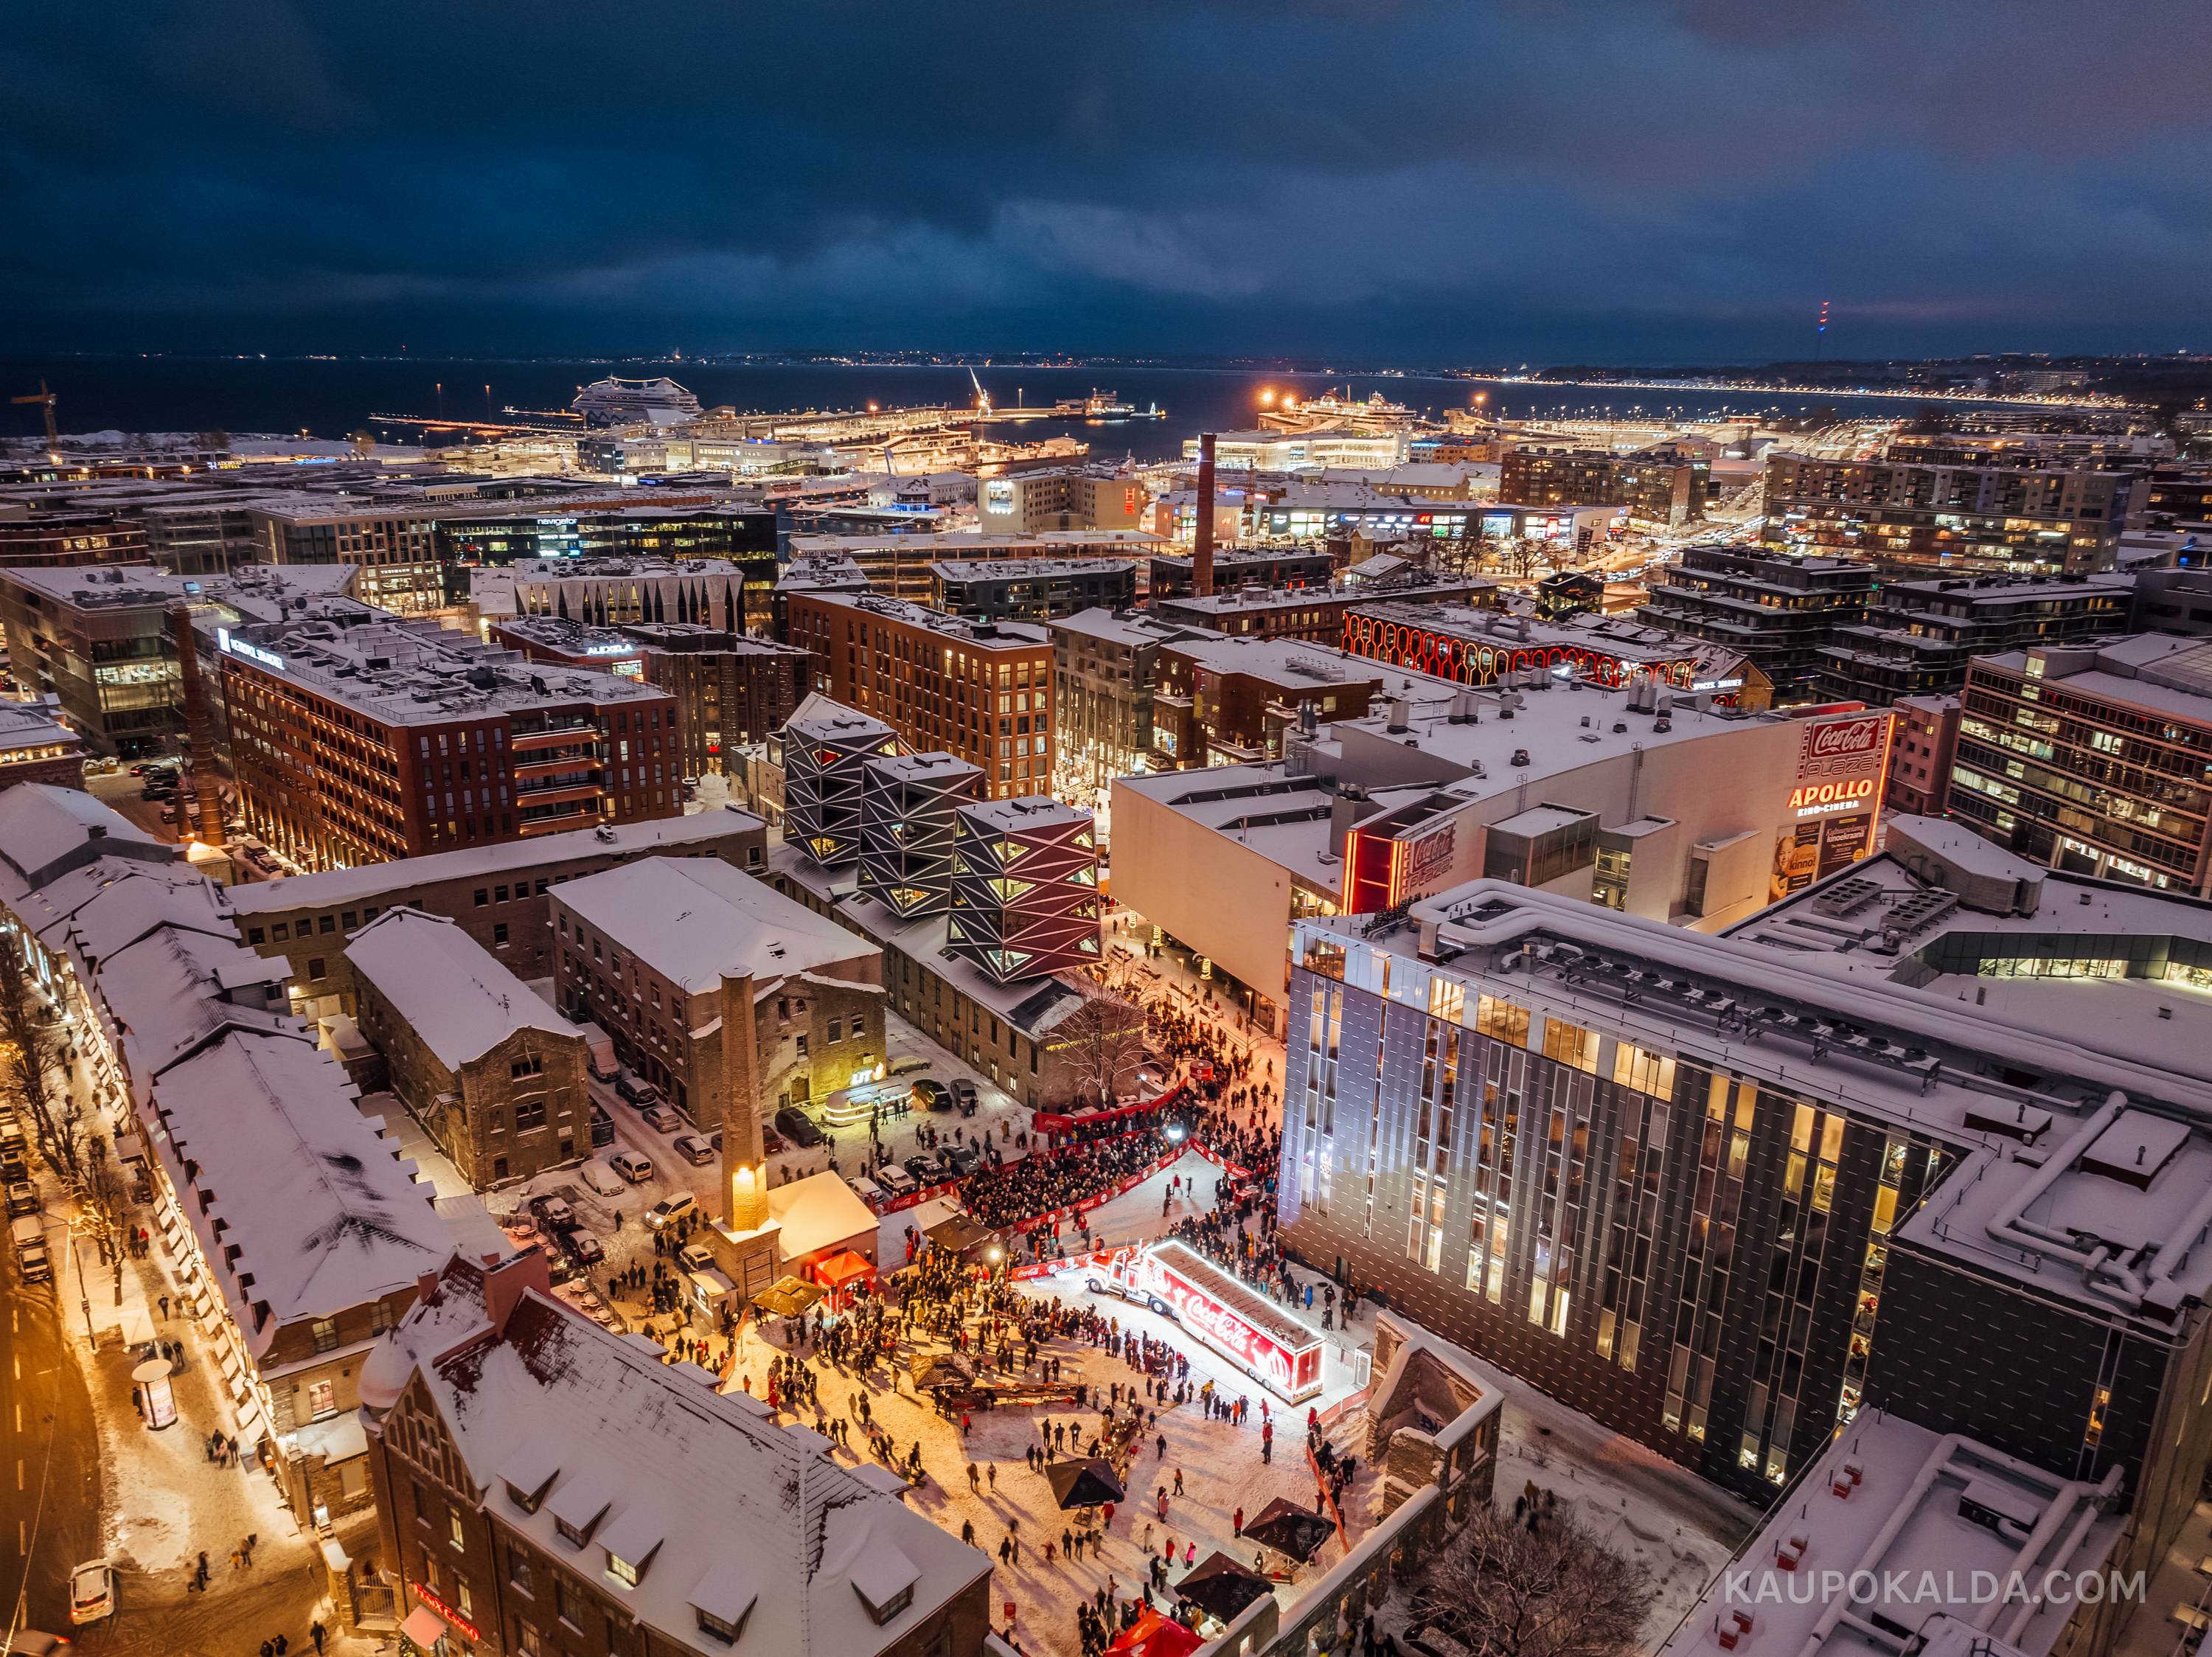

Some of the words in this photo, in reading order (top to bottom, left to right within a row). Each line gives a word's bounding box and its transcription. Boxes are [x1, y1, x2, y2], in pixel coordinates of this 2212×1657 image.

[537, 518, 578, 526] navigator
[1814, 720, 1877, 754] Coca-Cola
[1788, 779, 1873, 808] APOLLO
[1790, 858, 1816, 870] kinno!
[1018, 1267, 1040, 1277] Coca-Cola
[1186, 1295, 1251, 1354] Coca-Cola
